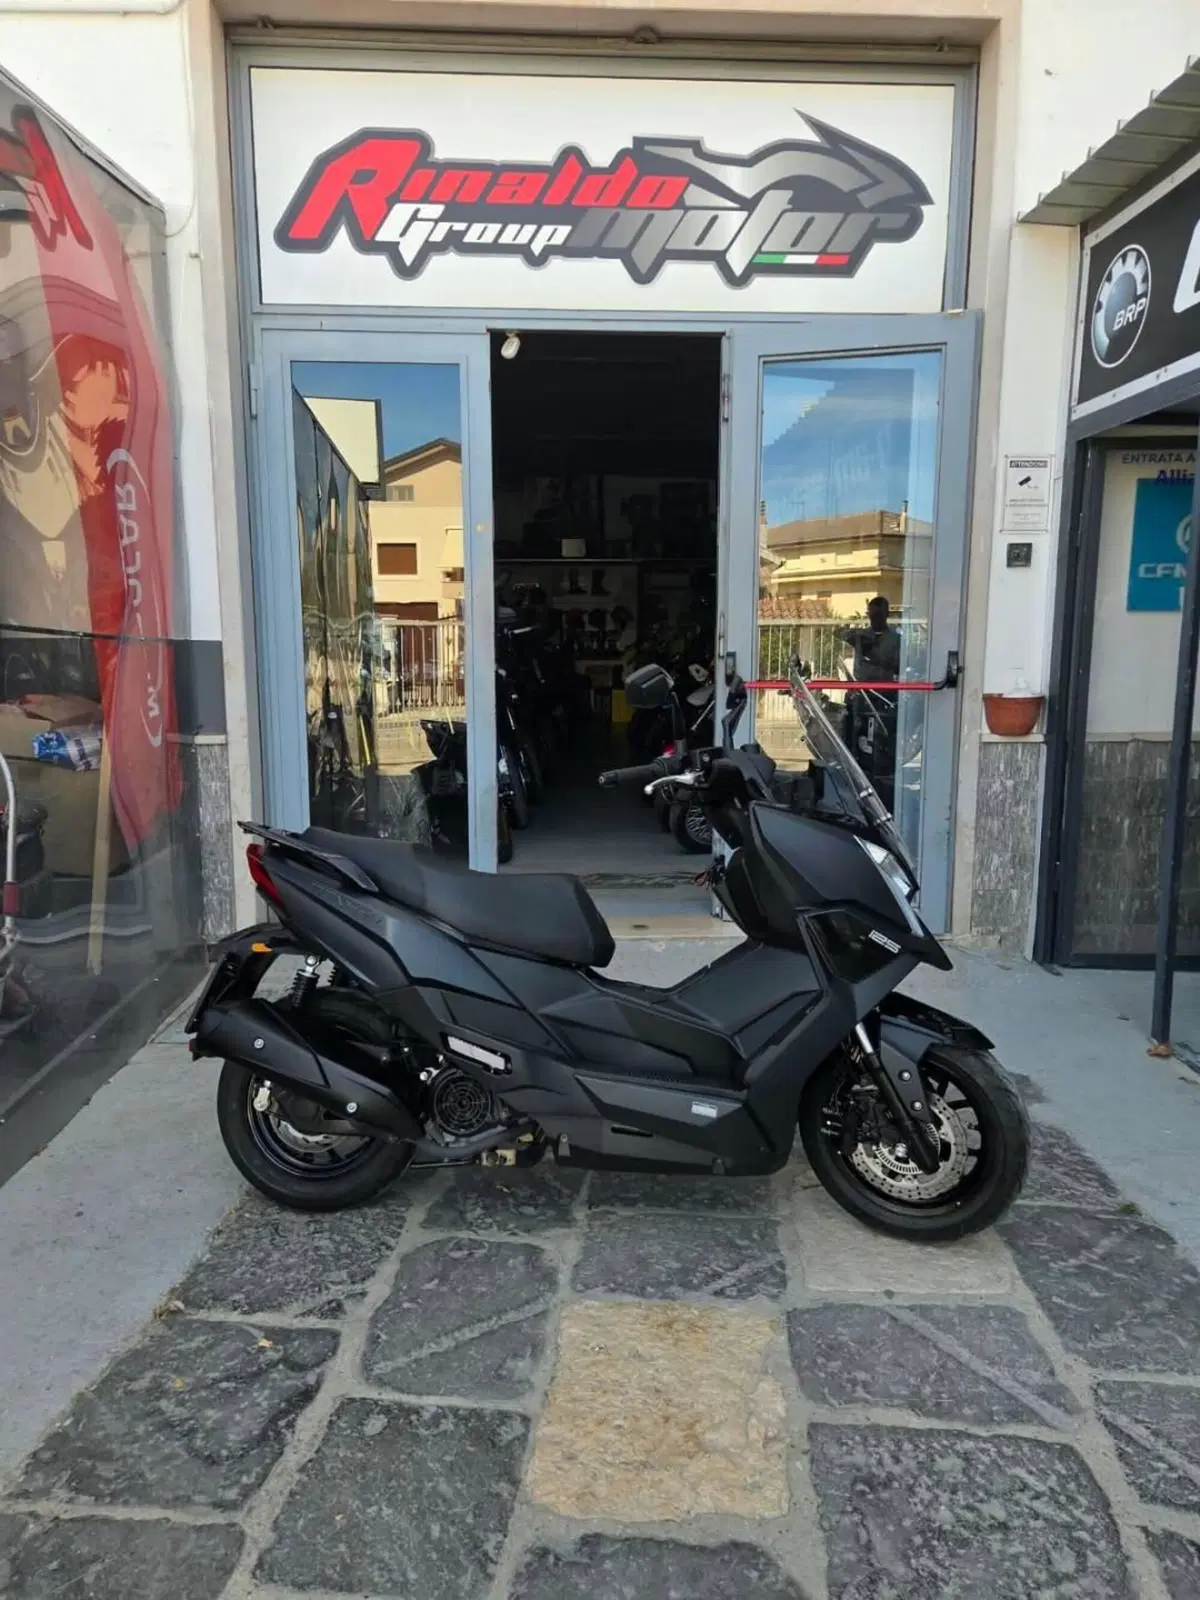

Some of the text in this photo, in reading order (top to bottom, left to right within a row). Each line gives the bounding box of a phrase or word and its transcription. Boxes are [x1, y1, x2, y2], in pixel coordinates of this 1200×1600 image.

[288, 139, 690, 240] Rinaldo
[374, 203, 573, 267] Group
[1113, 297, 1148, 331] BRP
[1121, 452, 1183, 465] ENTRATA
